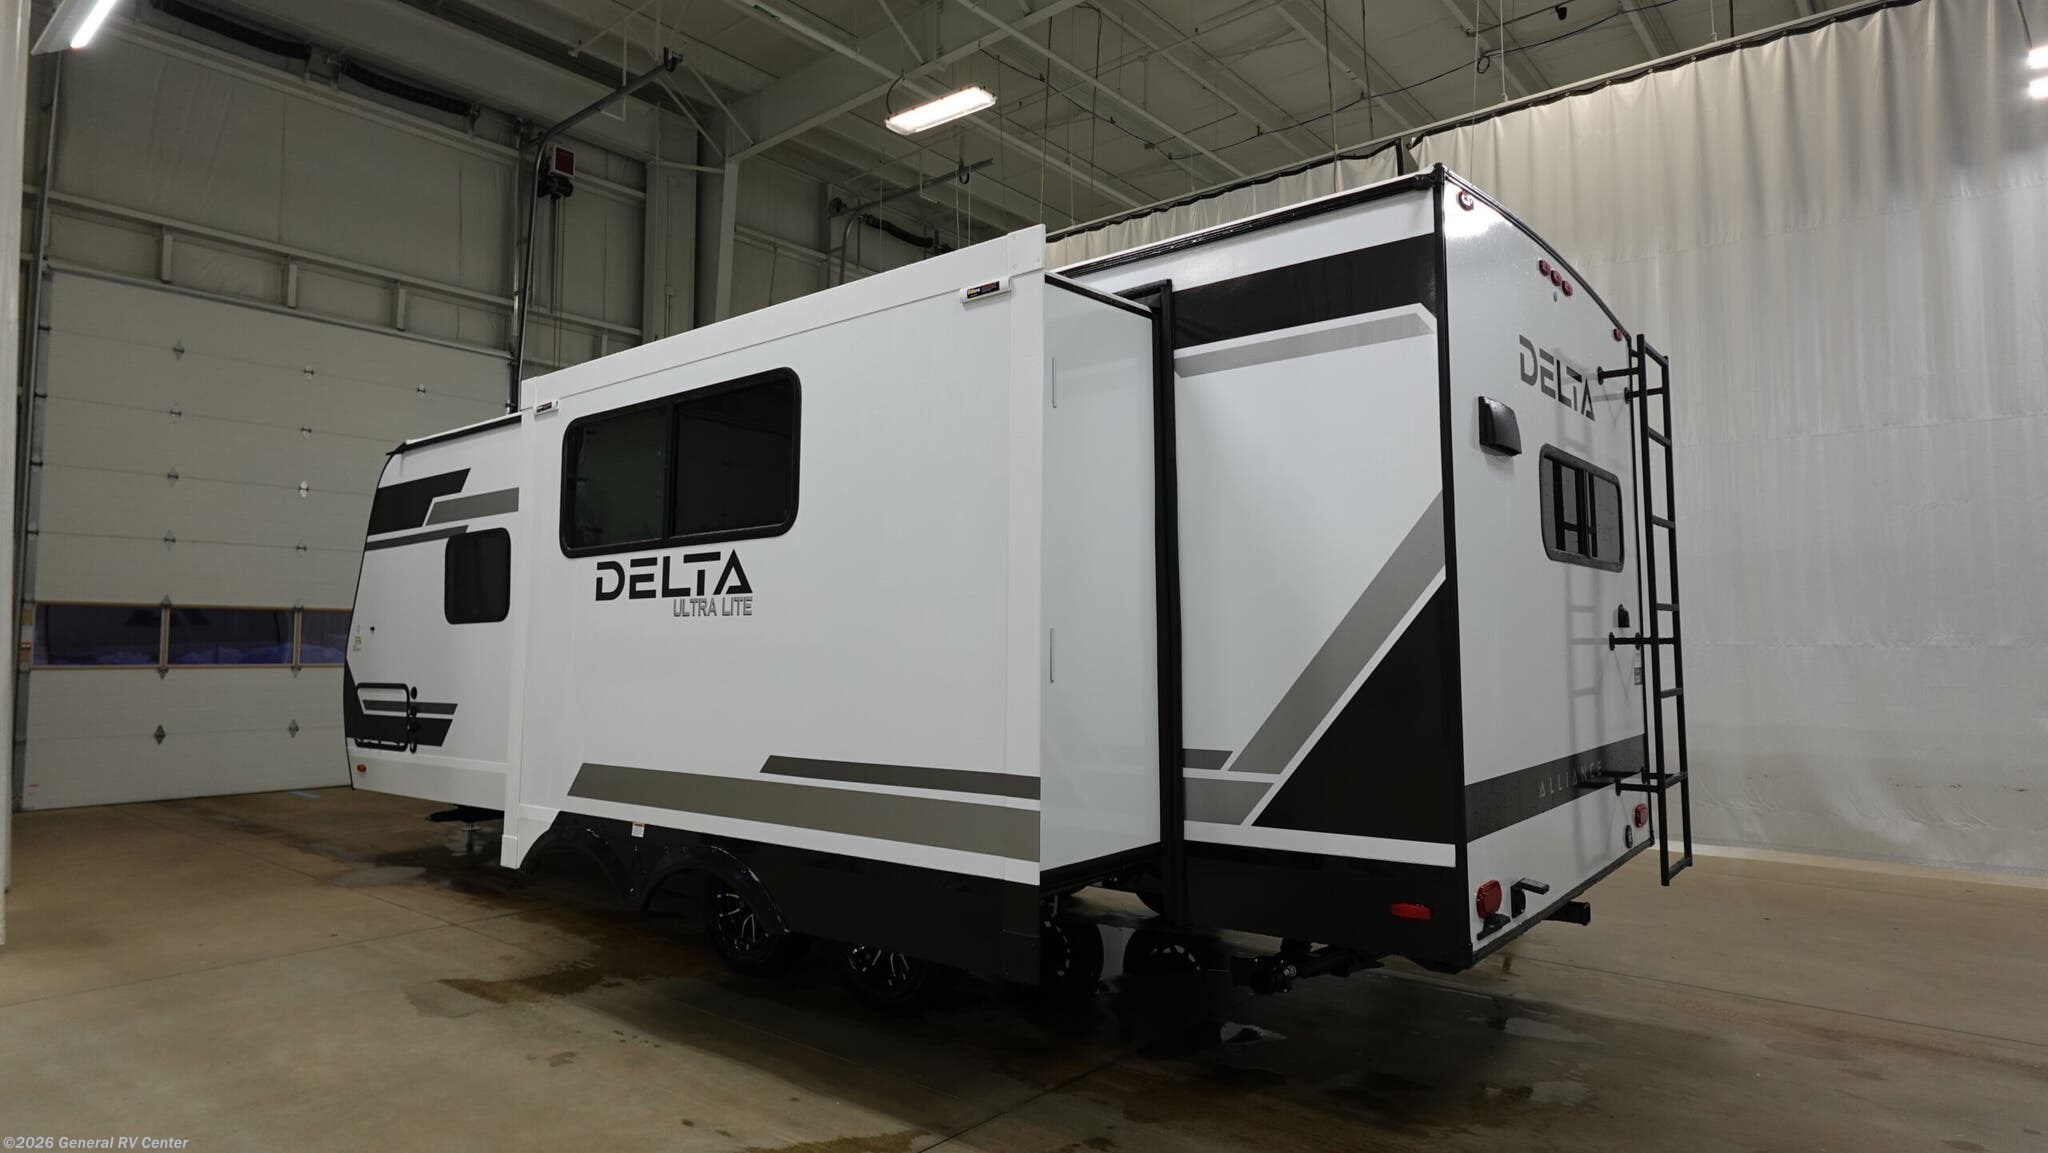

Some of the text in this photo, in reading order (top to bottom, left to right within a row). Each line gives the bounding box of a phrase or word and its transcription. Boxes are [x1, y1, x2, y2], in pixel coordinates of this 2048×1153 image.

[1519, 333, 1595, 421] DELTA
[594, 549, 753, 601] DELTA
[673, 596, 753, 617] ULTRA LITE
[1539, 760, 1603, 798] ALLIANCE
